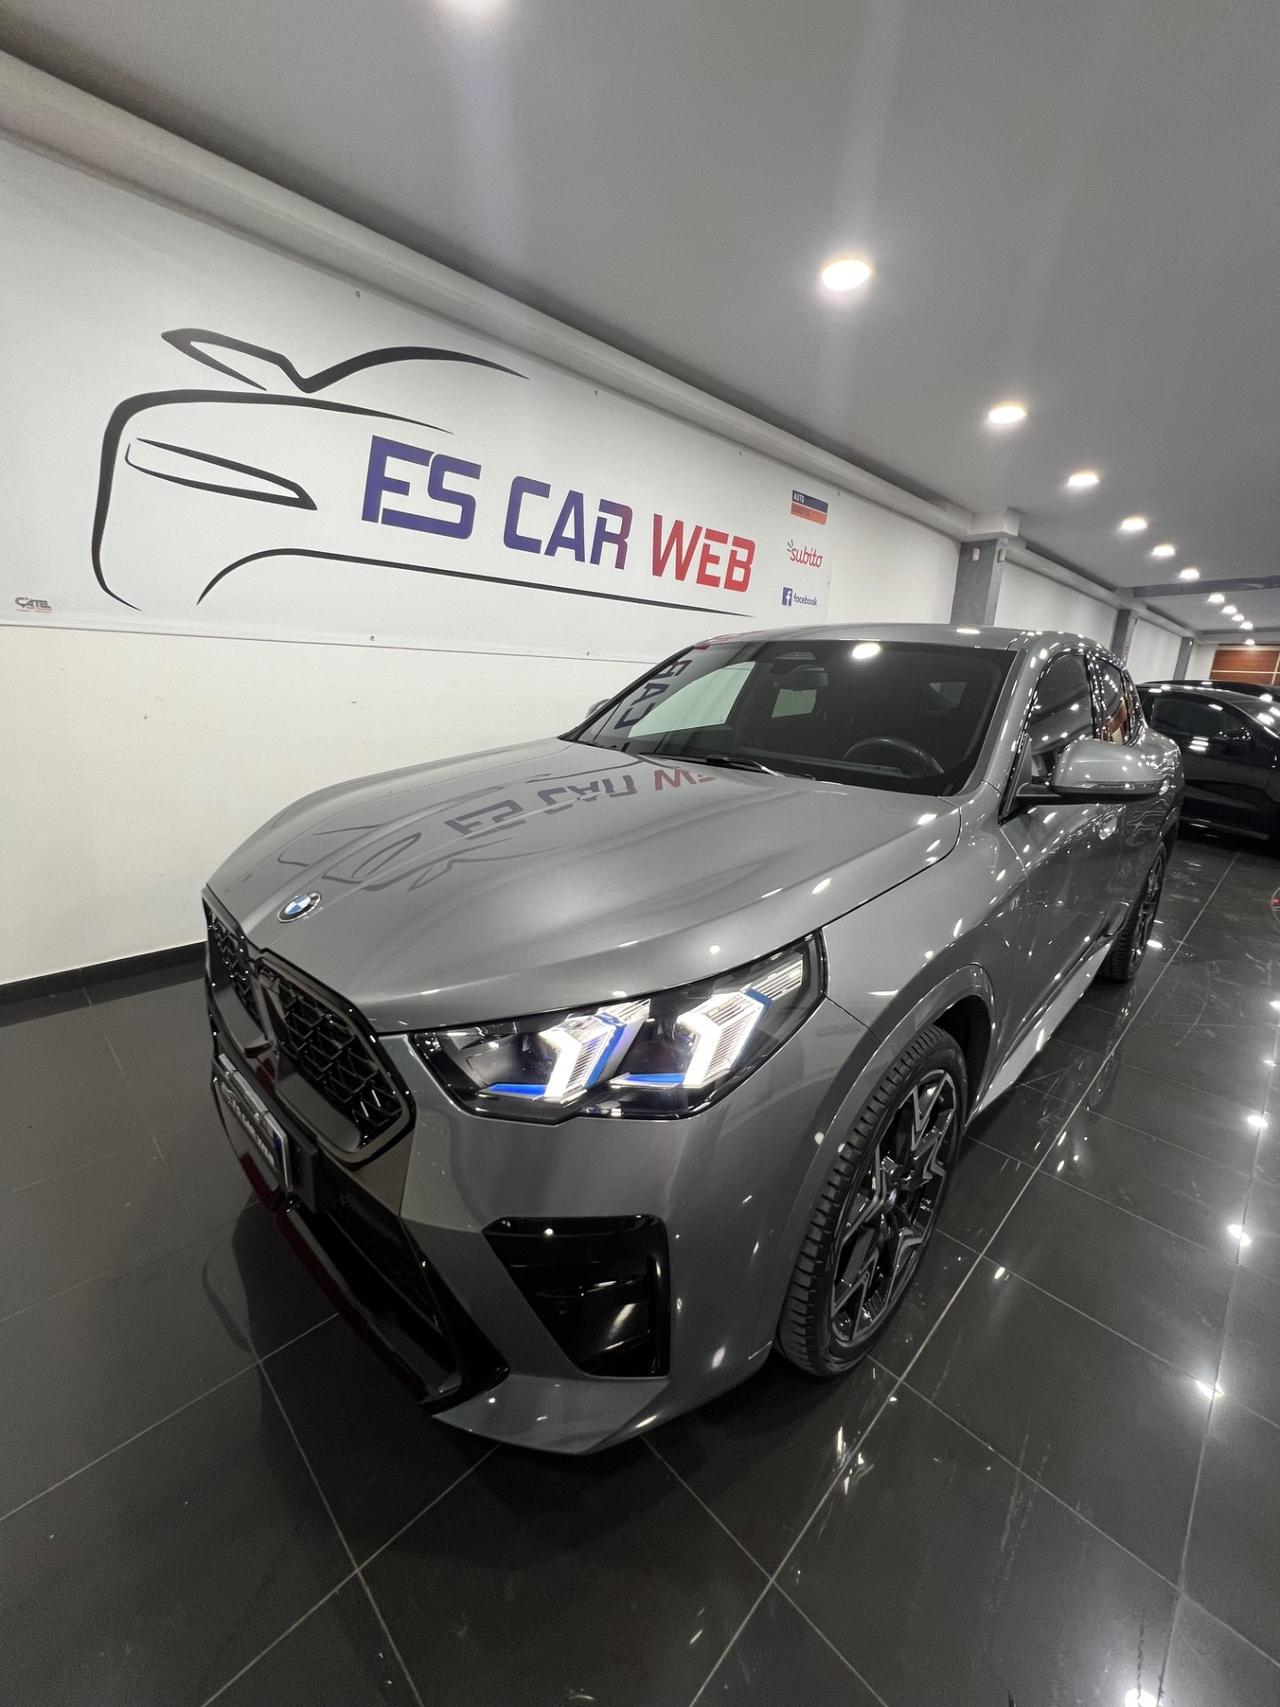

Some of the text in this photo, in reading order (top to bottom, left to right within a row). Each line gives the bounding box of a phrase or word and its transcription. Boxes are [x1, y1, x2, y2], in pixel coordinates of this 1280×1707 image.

[362, 435, 757, 593] ES CAR WEB
[790, 546, 823, 568] subito
[793, 593, 818, 606] facebook
